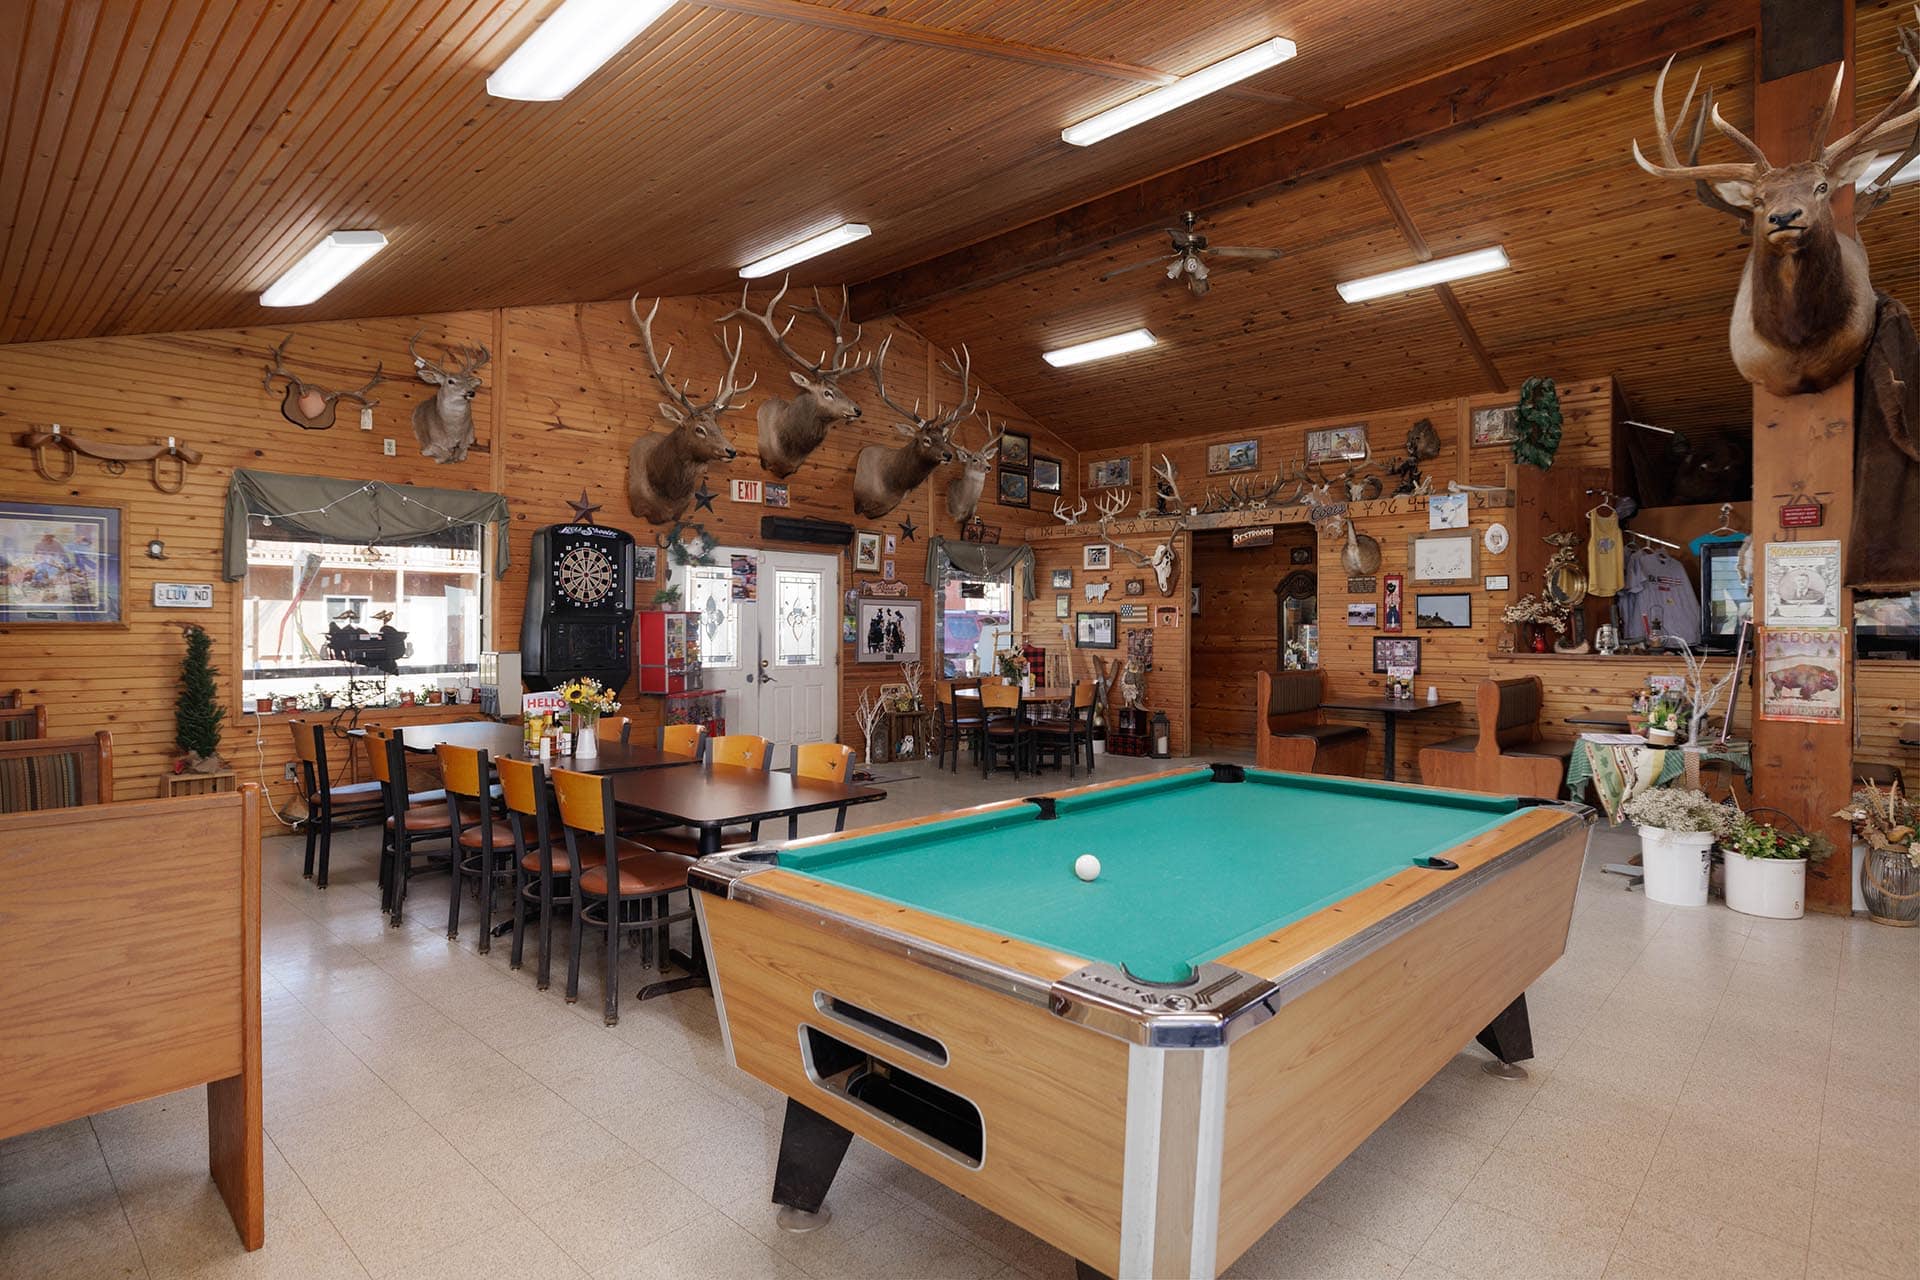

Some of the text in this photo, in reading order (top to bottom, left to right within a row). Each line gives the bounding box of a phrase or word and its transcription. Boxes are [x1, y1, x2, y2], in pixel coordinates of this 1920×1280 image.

[738, 481, 758, 500] EXIT
[1311, 502, 1346, 522] Coors
[1232, 529, 1274, 545] RESTROOMS
[166, 589, 187, 600] LUV
[194, 590, 209, 601] ND
[1767, 632, 1839, 644] MEDORA
[527, 698, 566, 708] HELLO
